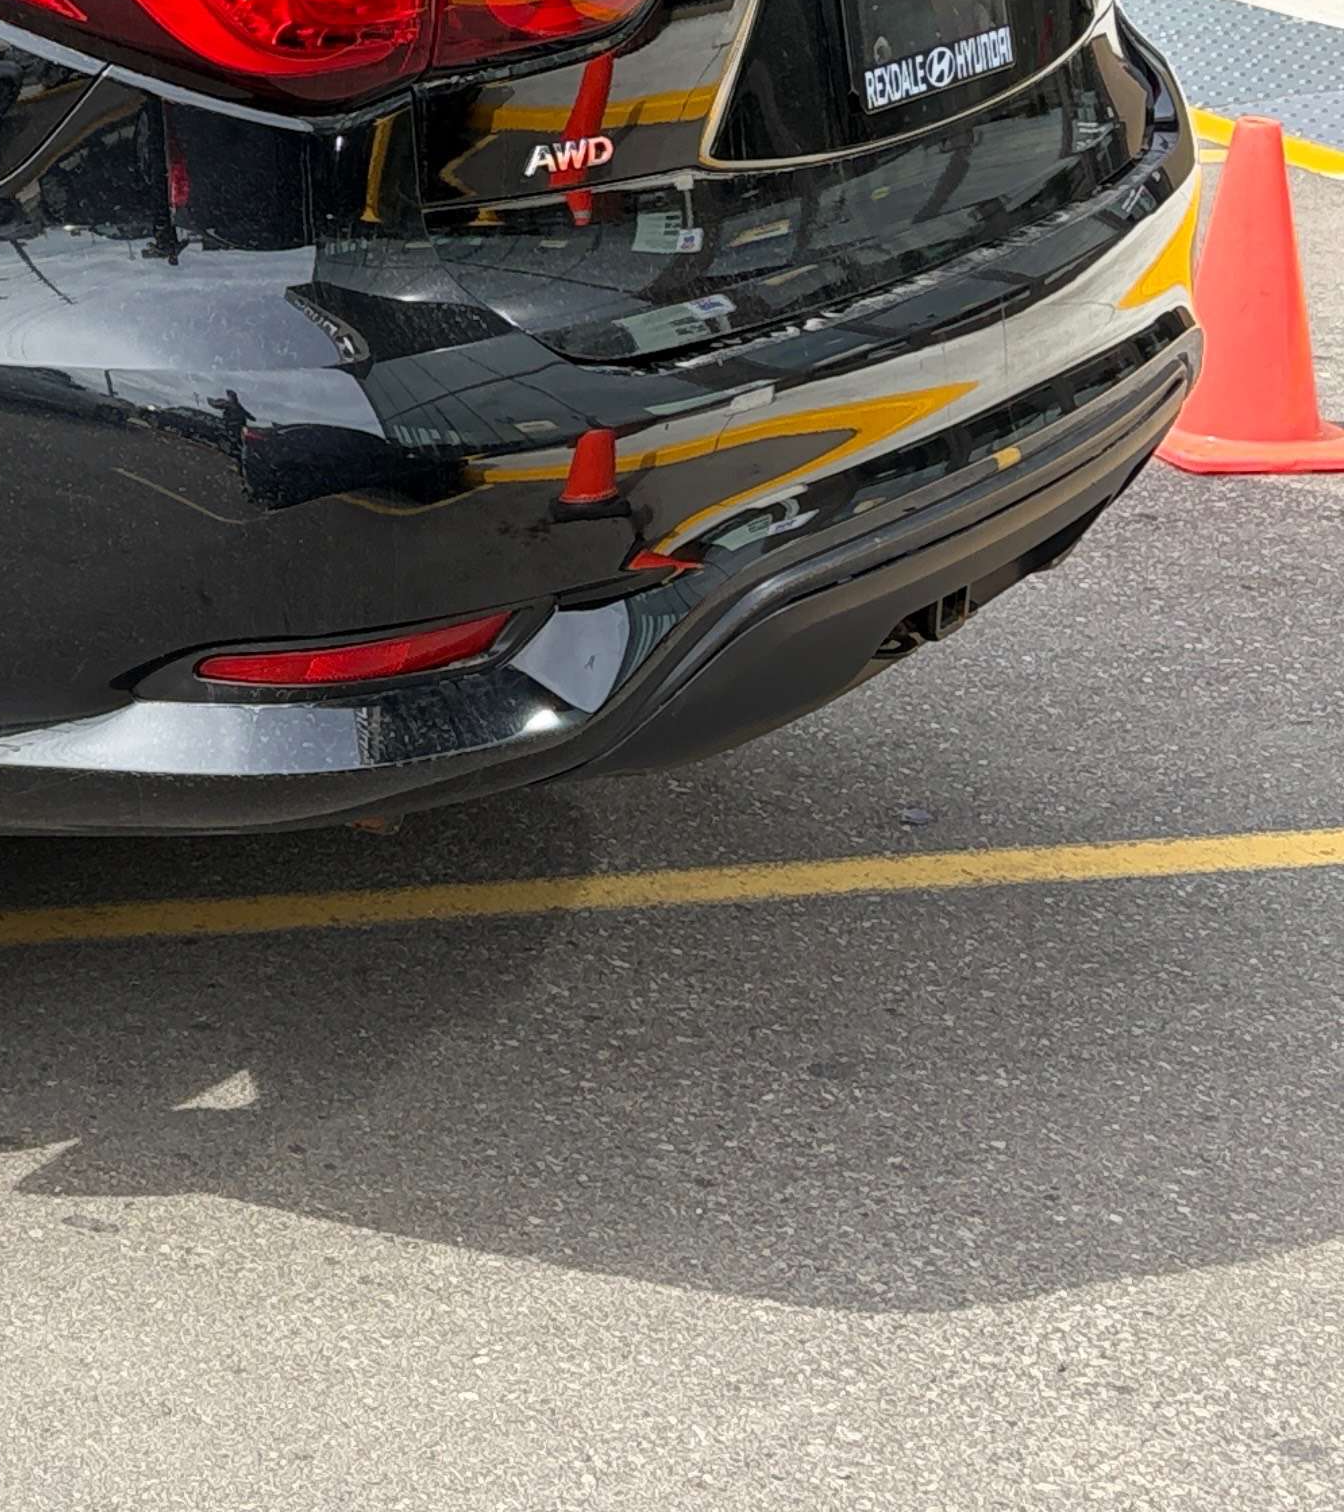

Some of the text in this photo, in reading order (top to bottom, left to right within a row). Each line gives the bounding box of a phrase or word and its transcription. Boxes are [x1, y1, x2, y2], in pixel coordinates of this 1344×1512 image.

[864, 26, 1014, 110] REXDALE HYUNDAI
[524, 136, 614, 177] AWD
